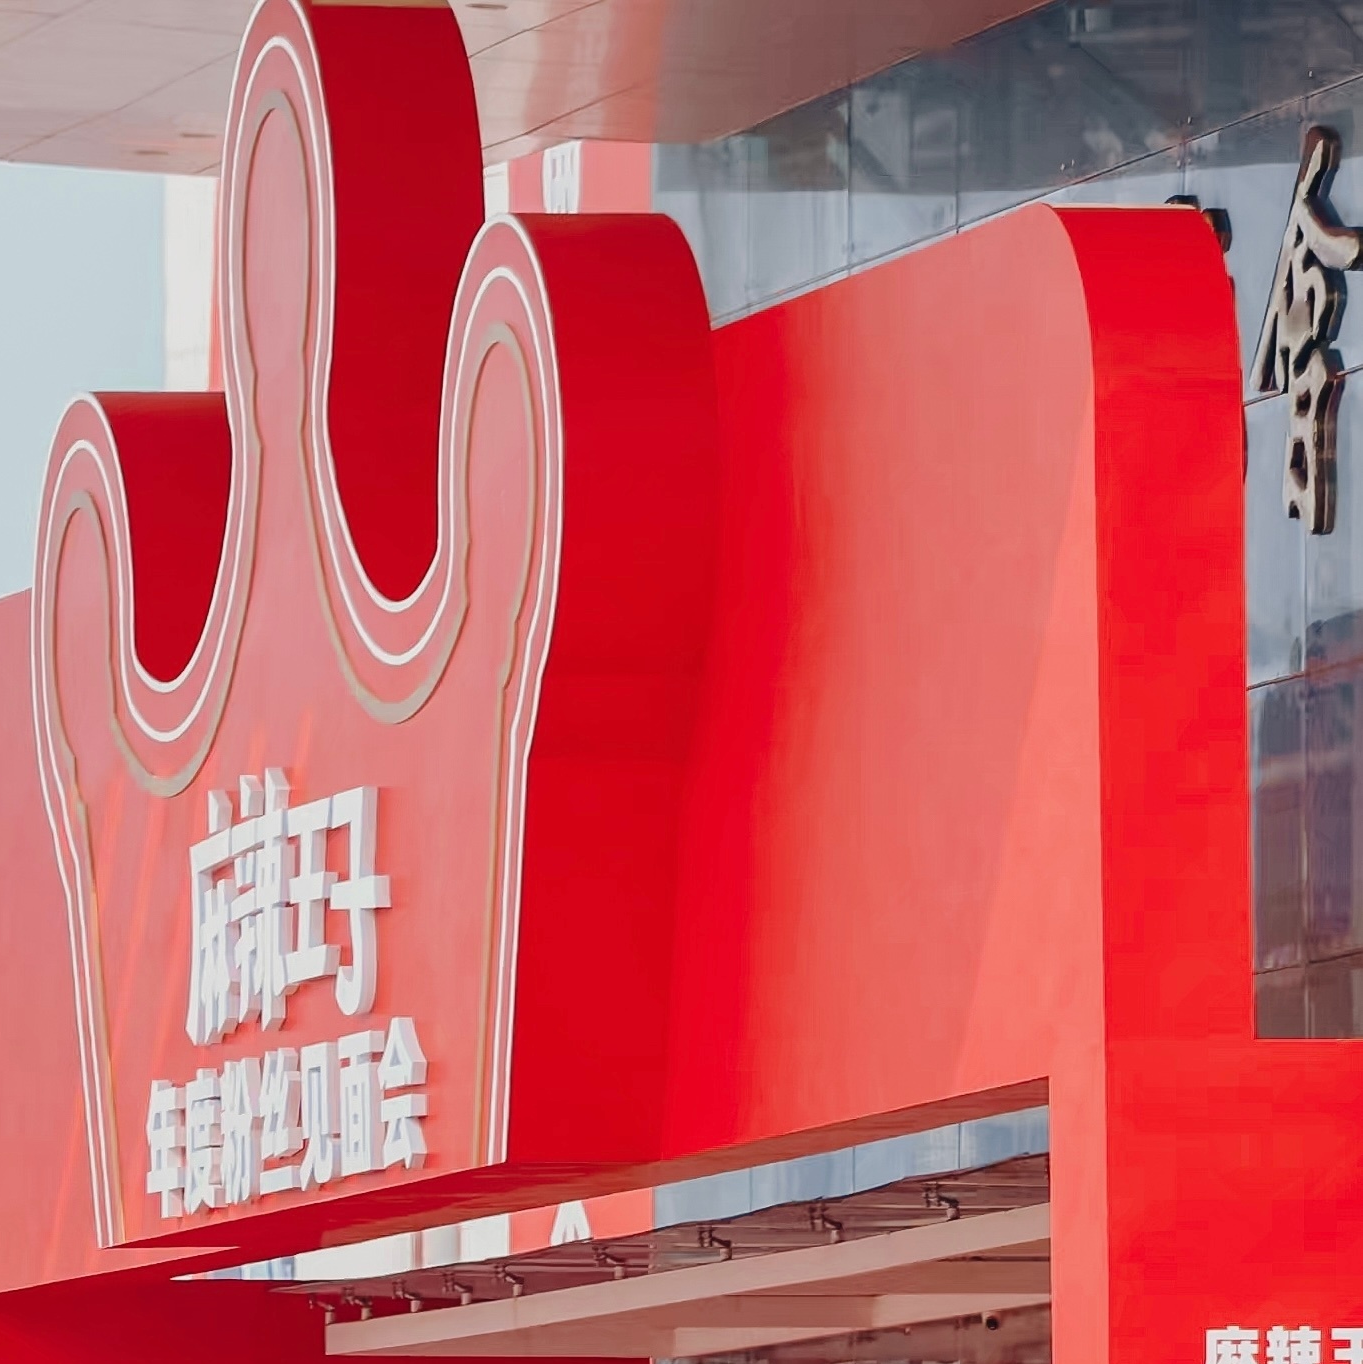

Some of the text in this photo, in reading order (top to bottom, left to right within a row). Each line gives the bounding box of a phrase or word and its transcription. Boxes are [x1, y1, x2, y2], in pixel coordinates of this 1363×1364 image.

[185, 767, 391, 1045] 麻辣王子
[146, 1016, 428, 1218] 年度粉丝见面会
